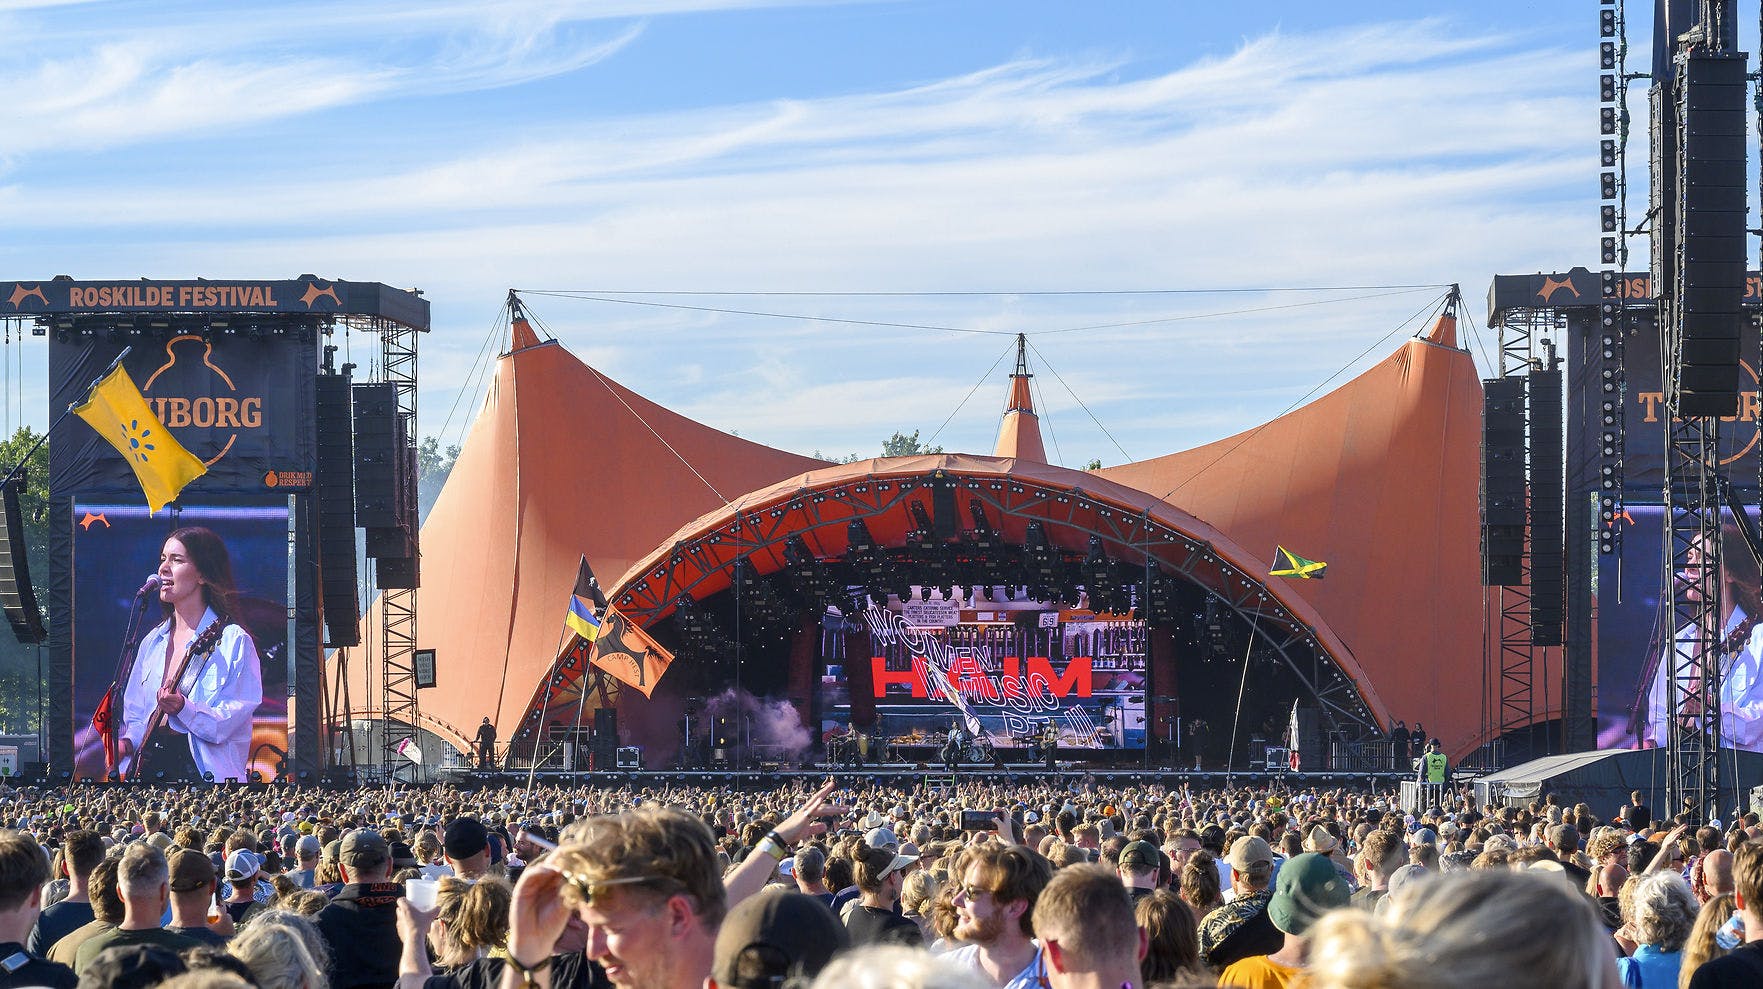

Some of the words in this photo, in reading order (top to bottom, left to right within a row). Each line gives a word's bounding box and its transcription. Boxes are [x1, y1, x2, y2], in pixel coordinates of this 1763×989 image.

[70, 287, 174, 307] ROSKILDE
[179, 286, 277, 307] FESTIVAL
[143, 396, 262, 428] UBORG
[279, 471, 296, 479] DRIK
[279, 479, 312, 487] RESPEKT
[863, 604, 994, 674] WOMEN
[608, 653, 629, 662] CAMP
[958, 672, 1060, 713] MUSIC
